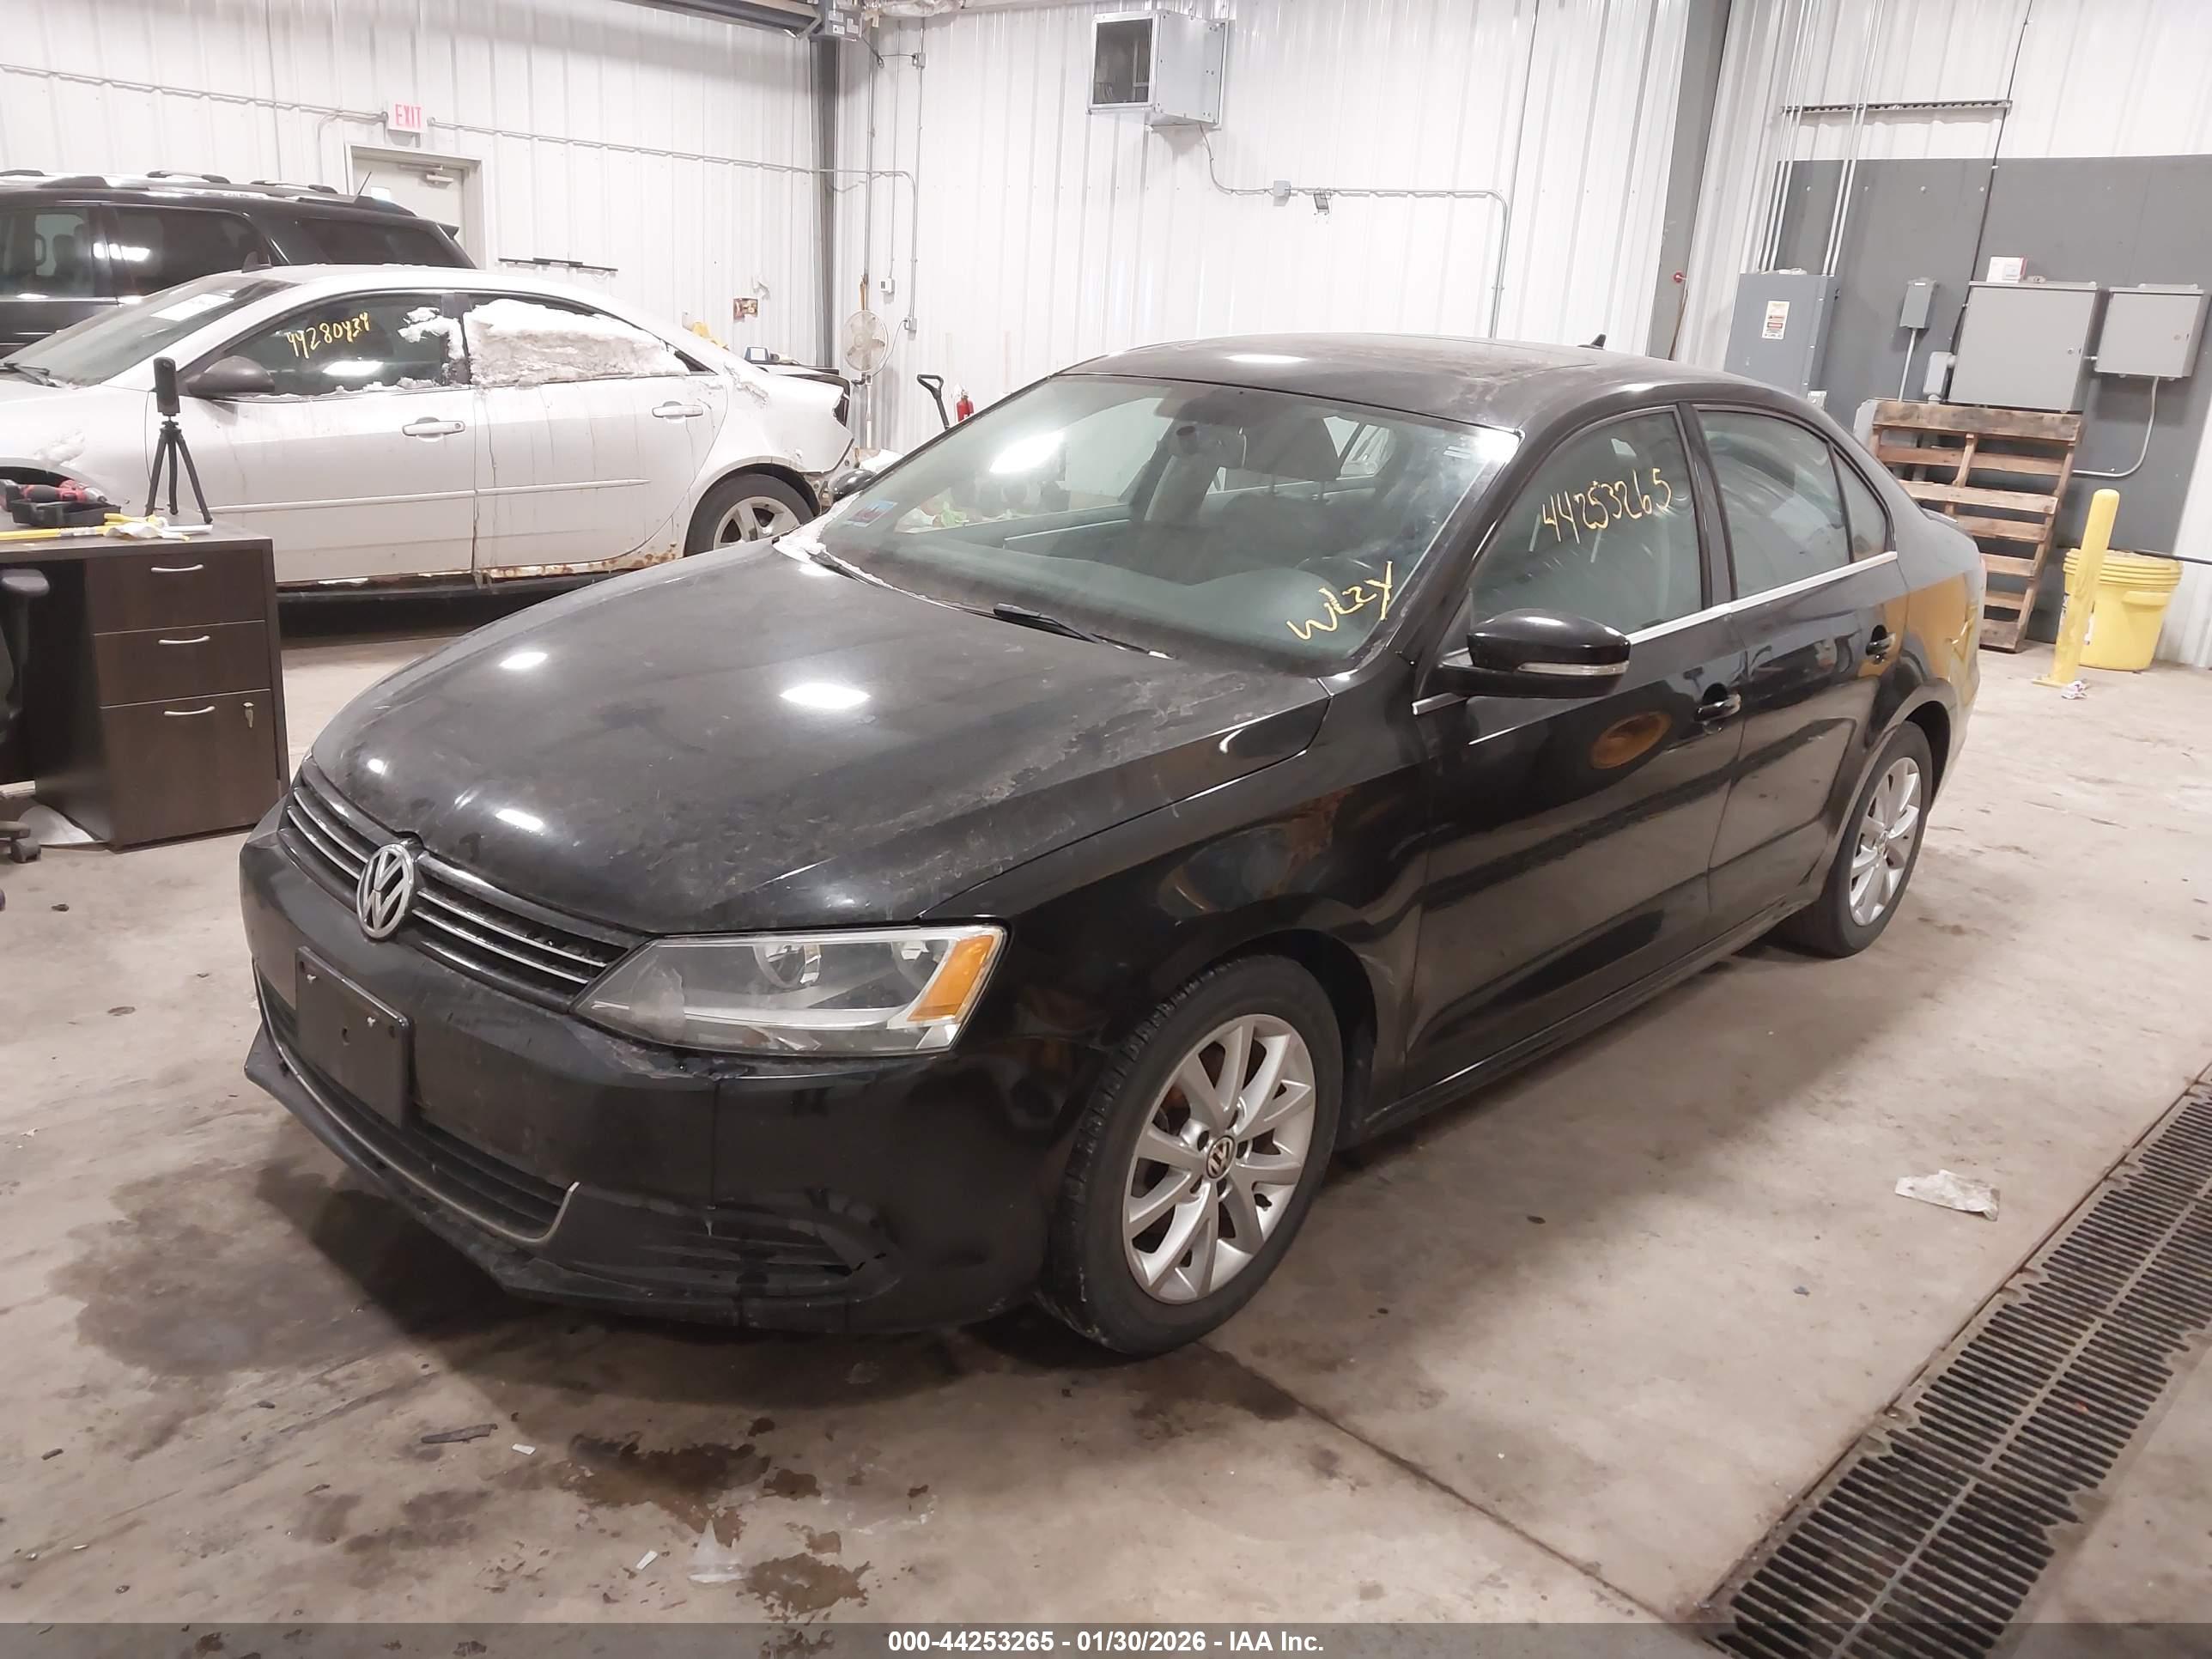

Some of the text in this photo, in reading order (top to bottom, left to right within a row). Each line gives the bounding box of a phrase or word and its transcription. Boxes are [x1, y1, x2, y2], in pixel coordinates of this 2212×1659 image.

[394, 103, 422, 129] EXIT
[1542, 468, 1671, 544] 44253265
[356, 843, 414, 939] VW
[1207, 1136, 1234, 1178] VW
